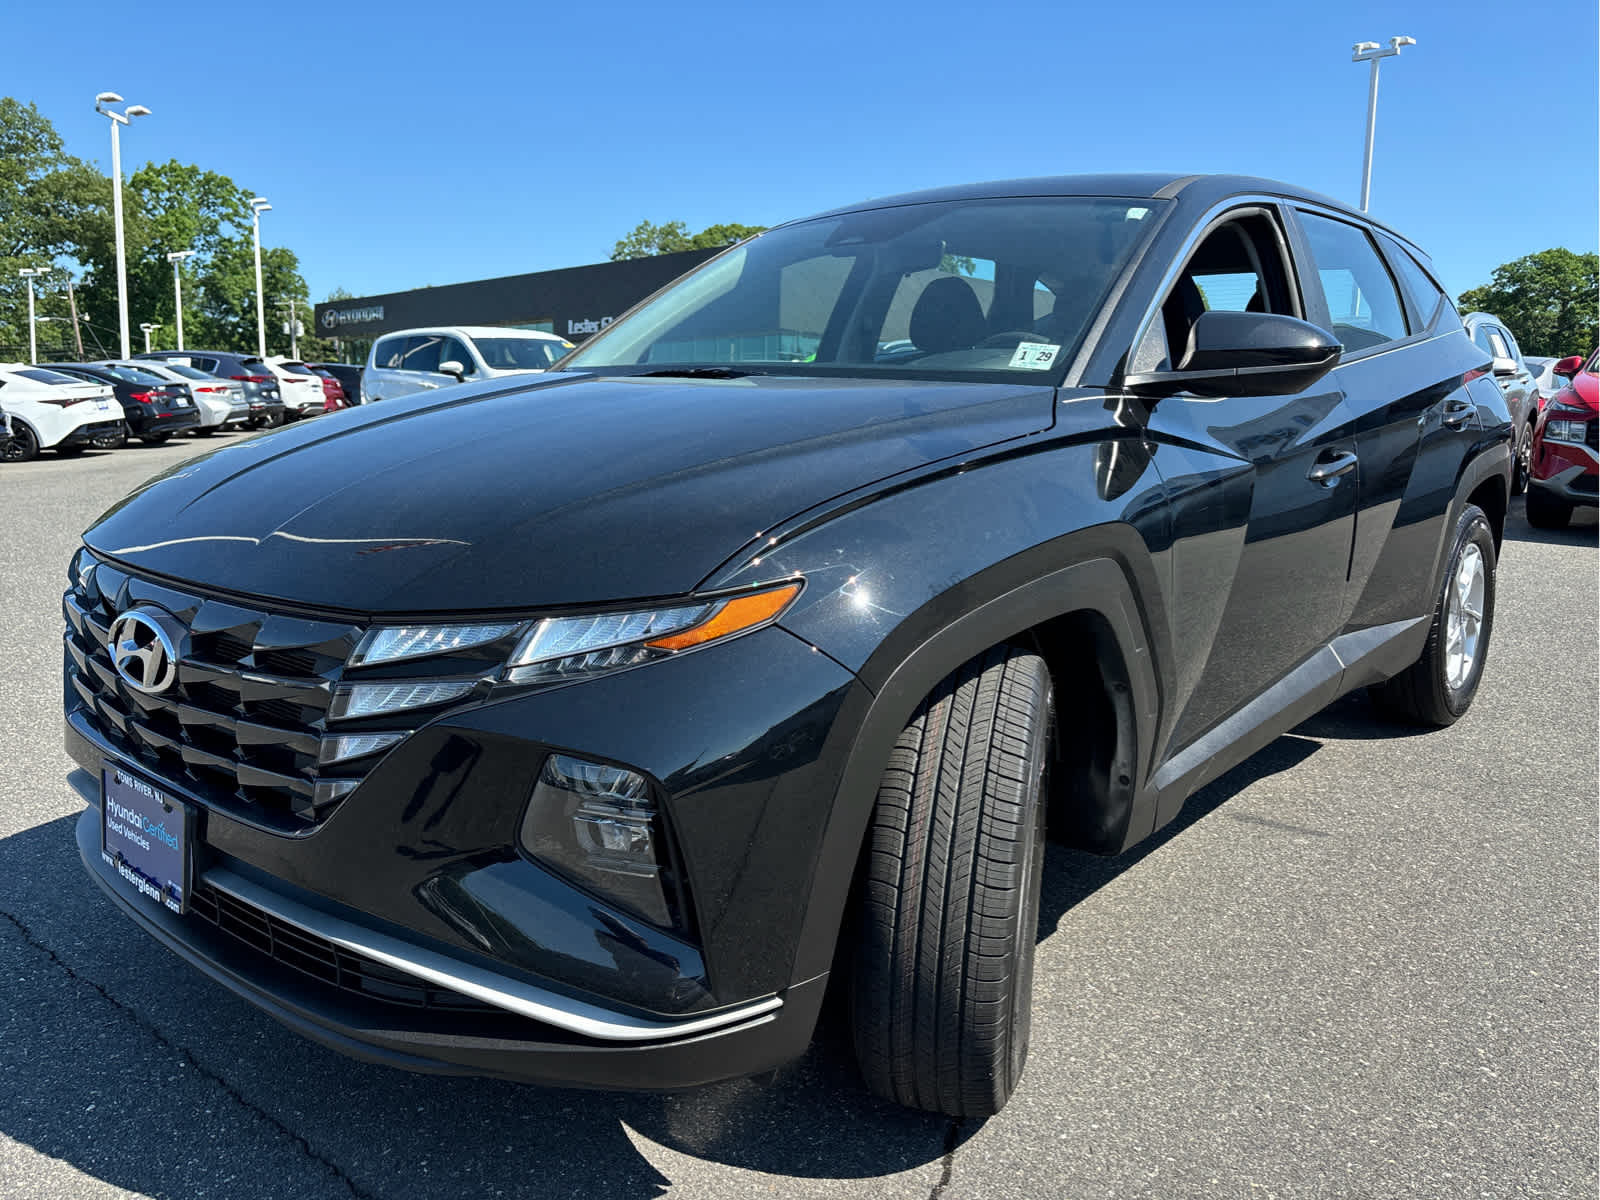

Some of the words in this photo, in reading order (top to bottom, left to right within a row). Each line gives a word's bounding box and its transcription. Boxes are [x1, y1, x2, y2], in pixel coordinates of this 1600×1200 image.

[336, 306, 384, 324] HYUNDAI
[568, 319, 600, 335] Lester
[1020, 350, 1027, 361] 1
[1036, 351, 1053, 362] 29
[116, 770, 134, 788] TOMS
[154, 791, 164, 804] NJ
[107, 795, 142, 829] Hyundai
[142, 816, 178, 851] Certified
[107, 816, 123, 834] Used
[123, 825, 150, 851] Vehicles
